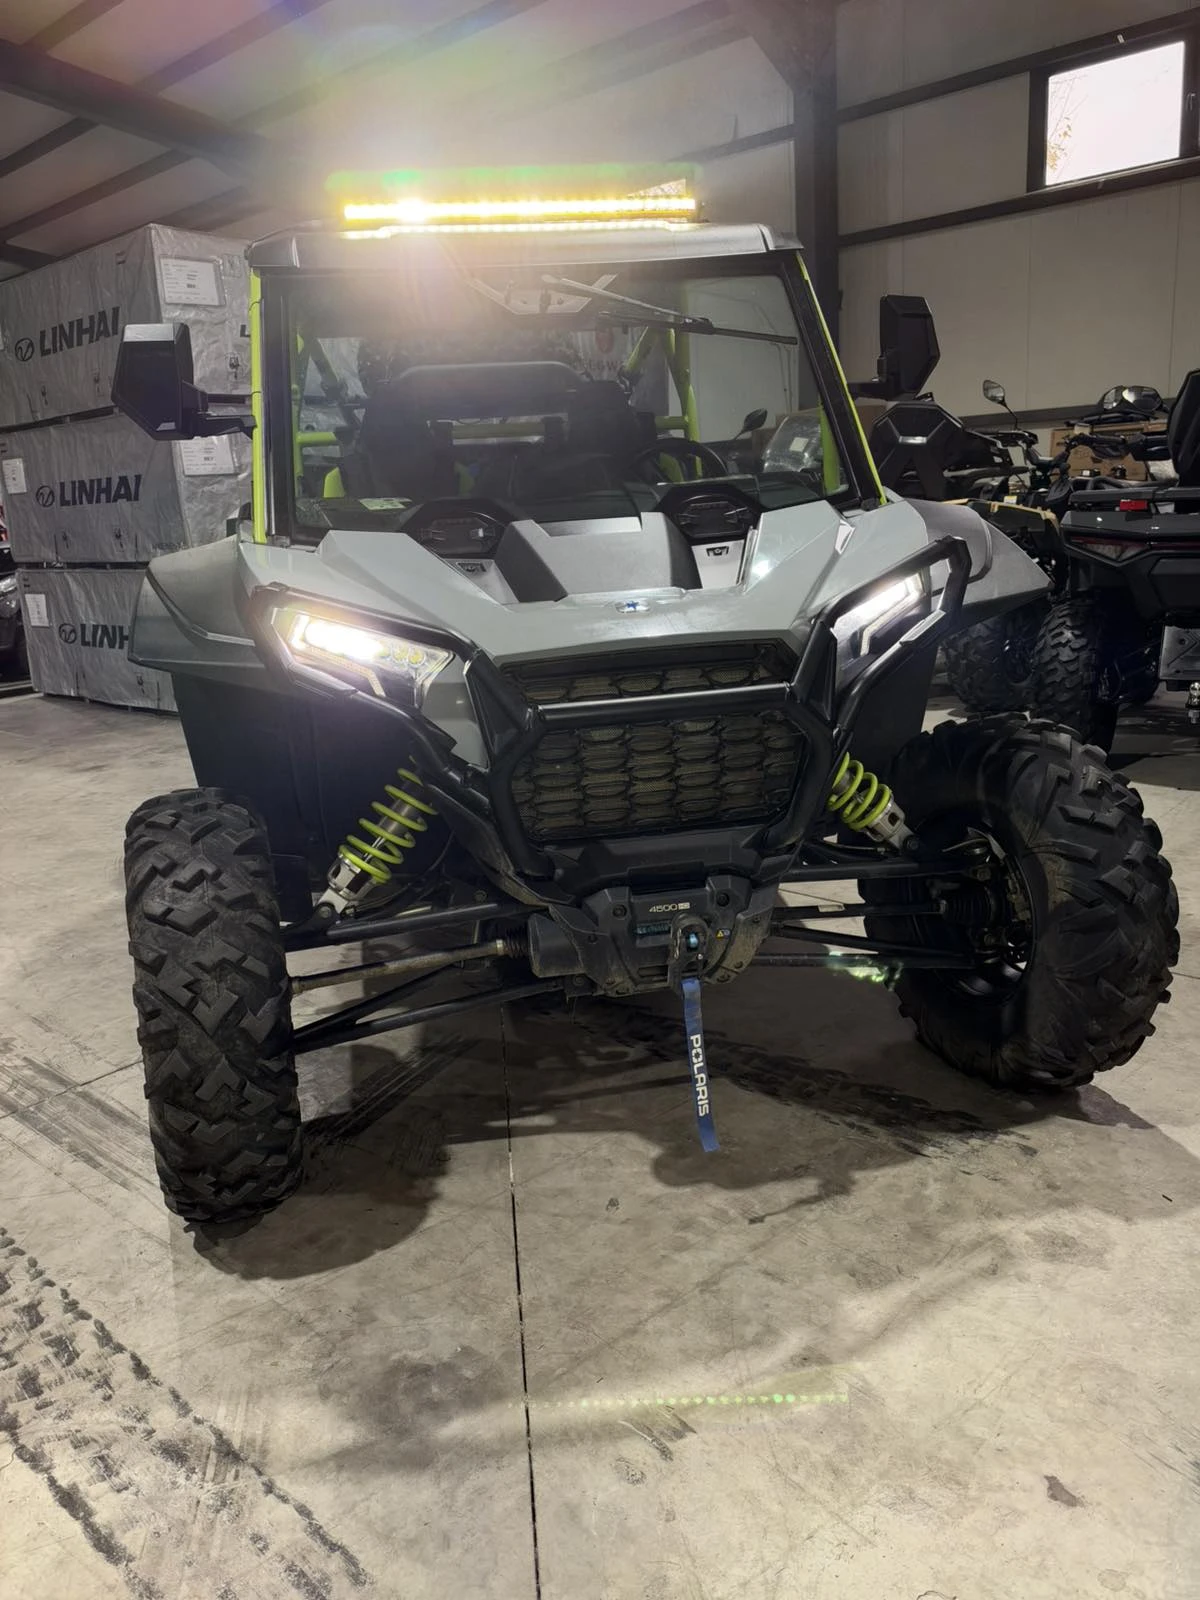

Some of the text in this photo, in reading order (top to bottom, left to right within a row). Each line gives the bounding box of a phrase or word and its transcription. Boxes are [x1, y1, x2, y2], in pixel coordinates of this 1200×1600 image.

[40, 306, 120, 357] LINHAI
[59, 474, 142, 507] LINHAI
[649, 903, 677, 913] 4500
[690, 1033, 709, 1117] POLARIS
